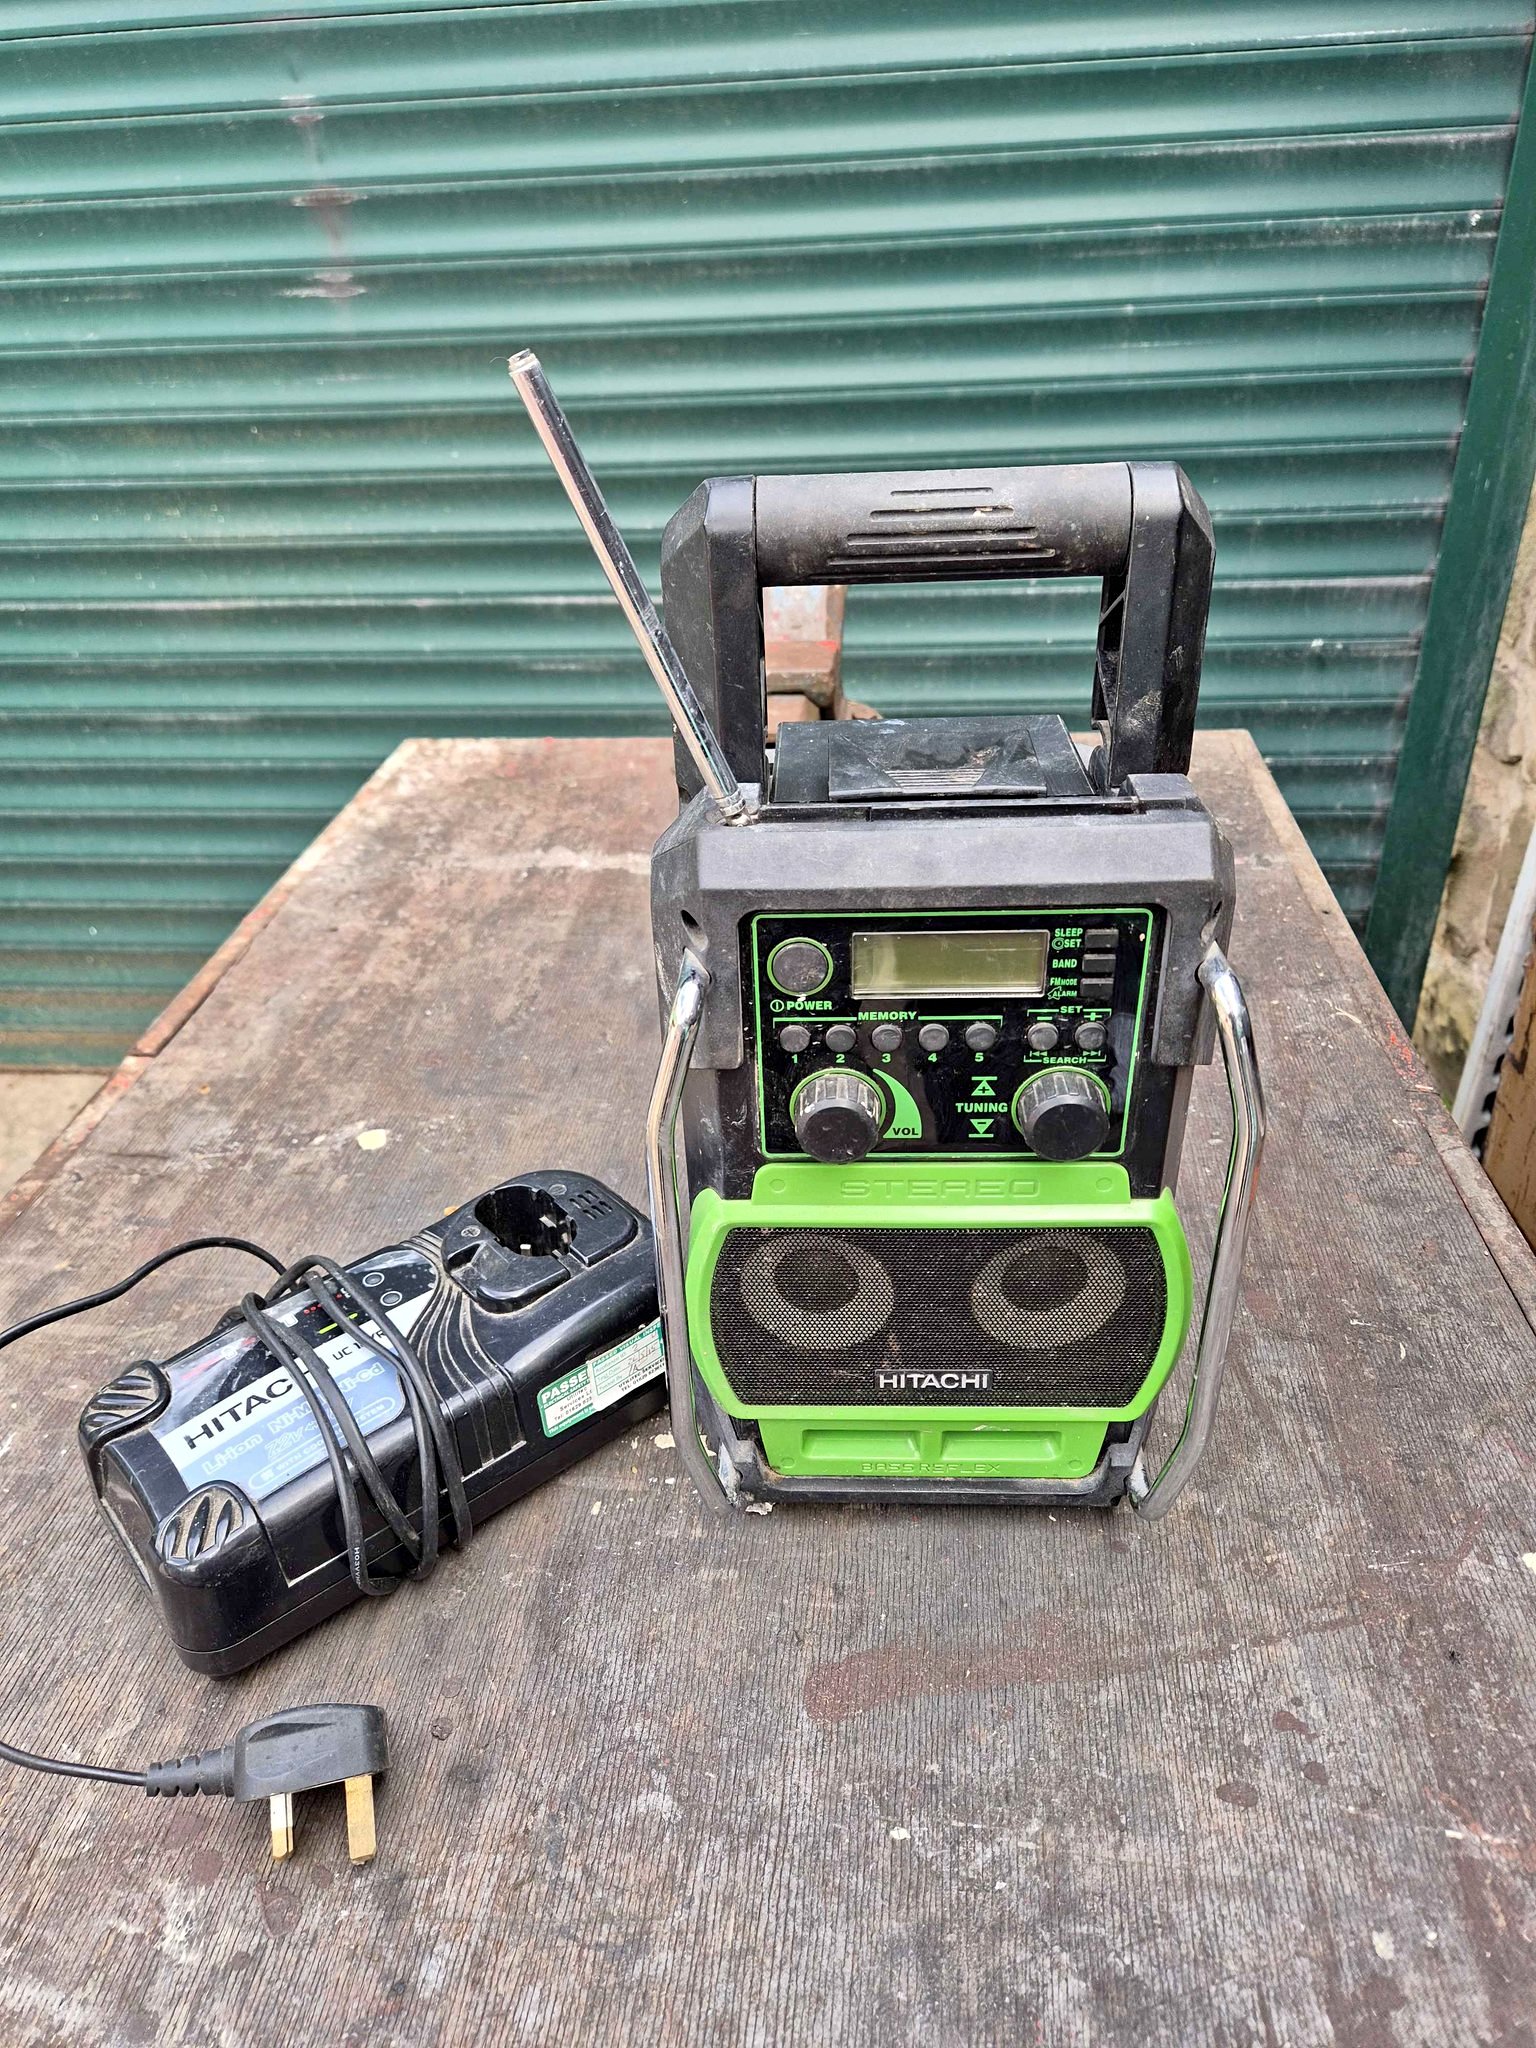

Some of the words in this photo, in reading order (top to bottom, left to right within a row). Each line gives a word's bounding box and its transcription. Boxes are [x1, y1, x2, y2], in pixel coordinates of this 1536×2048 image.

[1054, 928, 1083, 937] SLEEP
[1064, 939, 1082, 948] SET
[1052, 959, 1078, 968] BAND
[786, 1000, 833, 1011] POWER
[1060, 1005, 1083, 1013] SET
[858, 1011, 917, 1021] MEMORY
[791, 1054, 799, 1064] 1
[835, 1053, 846, 1063] 2
[881, 1053, 892, 1063] 3
[927, 1053, 938, 1063] 4
[974, 1053, 985, 1062] 5
[955, 1102, 1008, 1113] TUNING
[892, 1127, 919, 1136] VOL
[841, 1178, 1040, 1199] STEREO
[332, 1346, 352, 1360] UC
[541, 1368, 589, 1404] PASSE
[879, 1373, 989, 1390] HITACHI
[202, 1433, 264, 1475] Li-ion
[861, 1463, 915, 1473] BASS
[919, 1463, 1000, 1474] REFLEX
